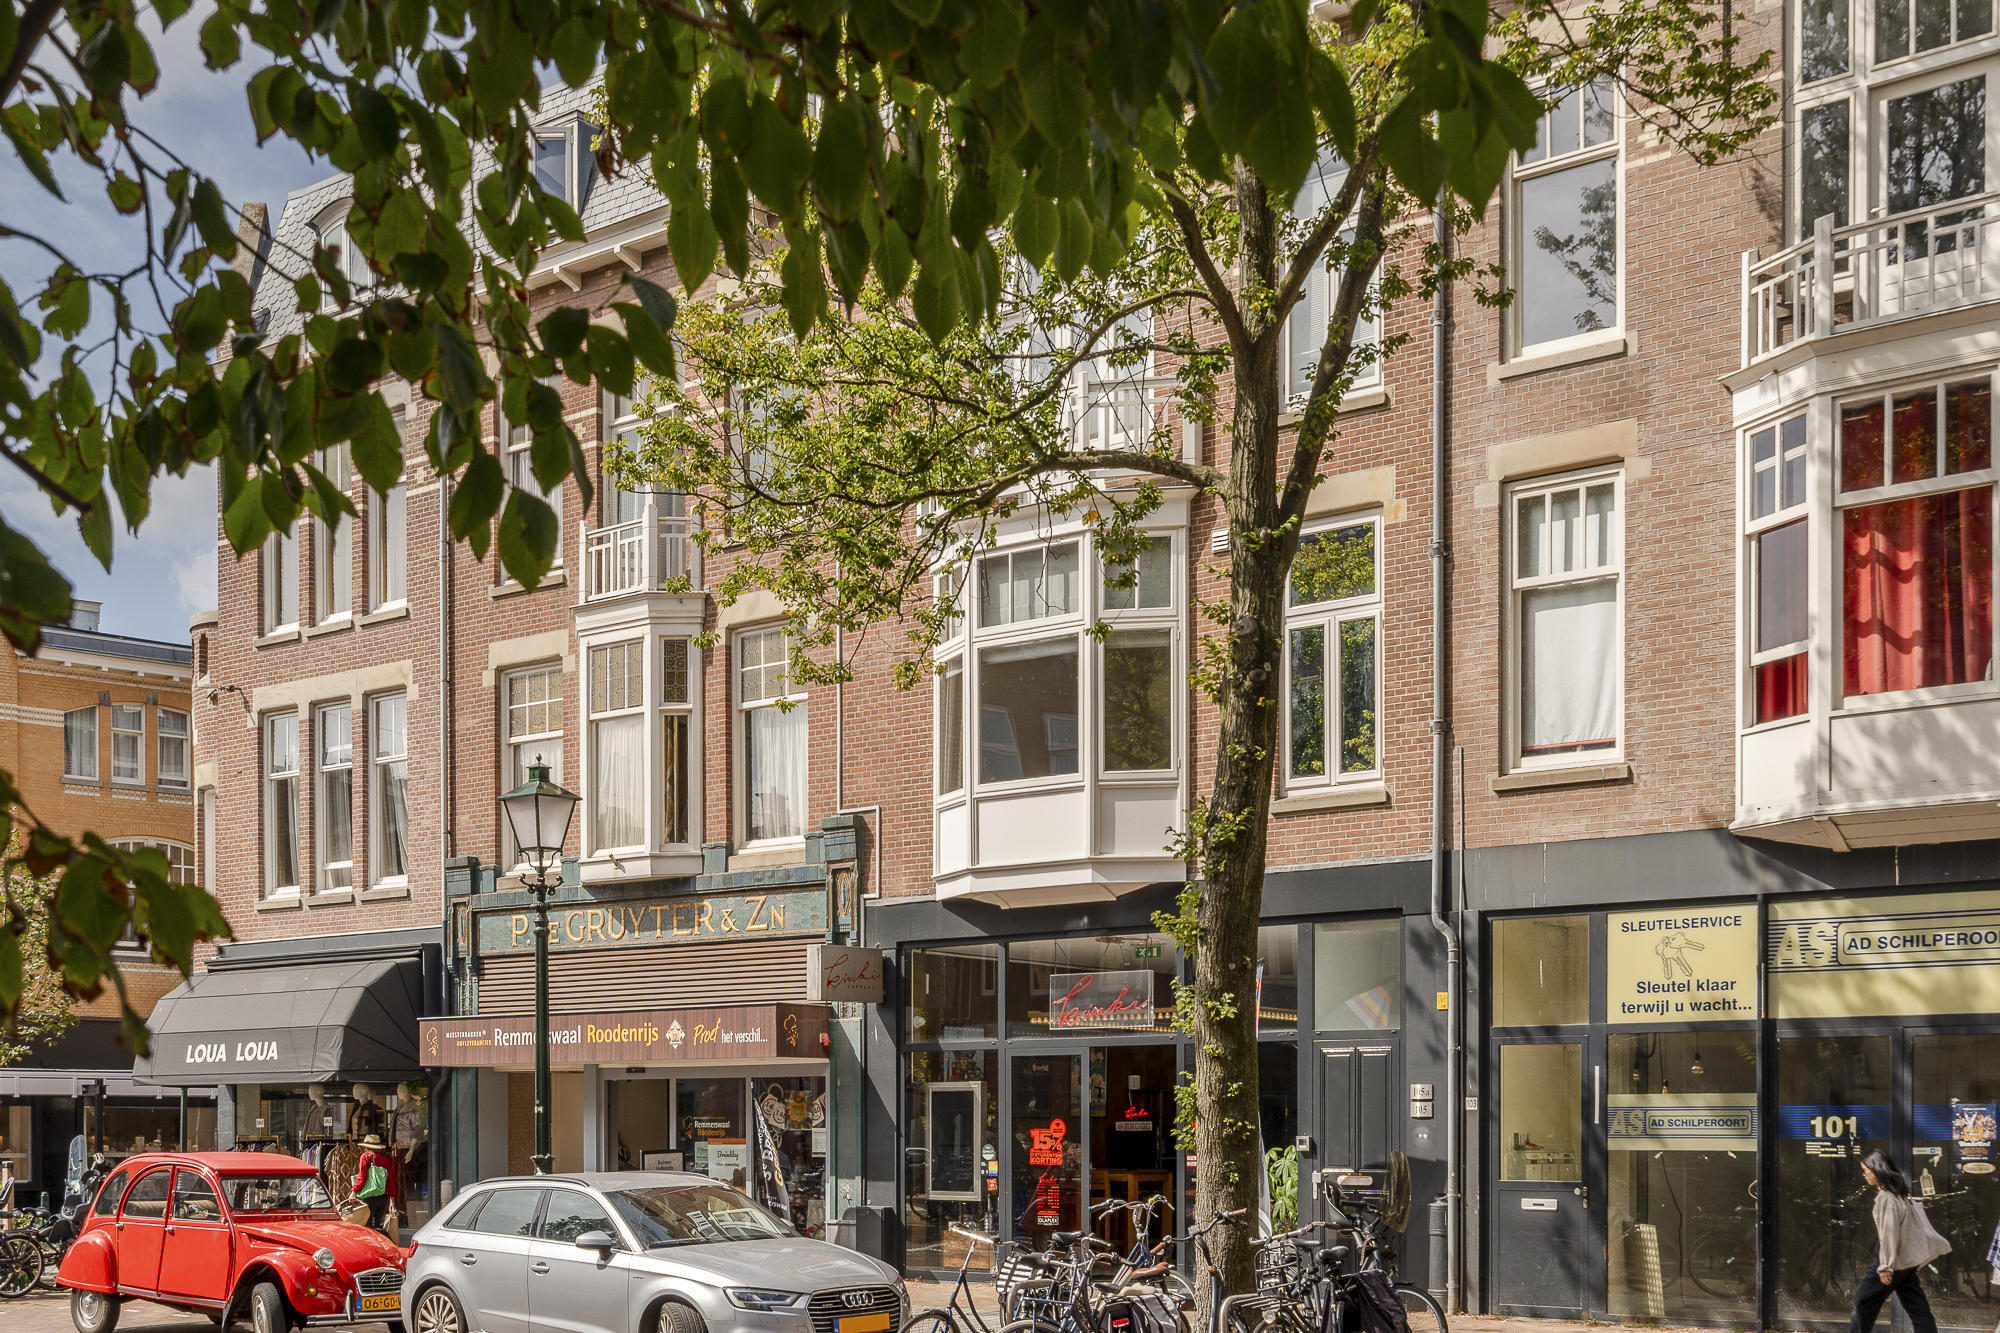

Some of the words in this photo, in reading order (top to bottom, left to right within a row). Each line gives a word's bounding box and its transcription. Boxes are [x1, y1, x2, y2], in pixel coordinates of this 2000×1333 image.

[566, 901, 716, 943] GRUYTER
[720, 908, 740, 933] &
[1621, 915, 1742, 933] SLEUTELSERVICE
[1771, 922, 1836, 967] AS
[1847, 937, 1872, 950] AD
[1877, 930, 2000, 950] SCHILPEROO
[1636, 979, 1691, 994] Sleutel
[1696, 979, 1737, 992] klaar
[1621, 1000, 1670, 1016] terwijl
[1675, 1002, 1684, 1012] u
[1690, 998, 1752, 1012] wacht...
[494, 1025, 581, 1047] Remmswaal
[587, 1022, 659, 1047] Roodenrijs
[721, 1029, 734, 1044] het
[734, 1027, 768, 1044] verschil...
[185, 1043, 227, 1064] LOUA
[236, 1041, 279, 1062] LOUA
[1413, 1087, 1430, 1096] 105a
[1415, 1105, 1428, 1114] 105
[1466, 1099, 1477, 1108] 103
[1608, 1109, 1645, 1136] AS
[1651, 1118, 1665, 1127] AD
[1667, 1118, 1747, 1128] SCHILPEROORT
[1810, 1115, 1858, 1138] 101
[1030, 1129, 1063, 1151] 15%
[364, 1296, 401, 1309] 06-GD-
